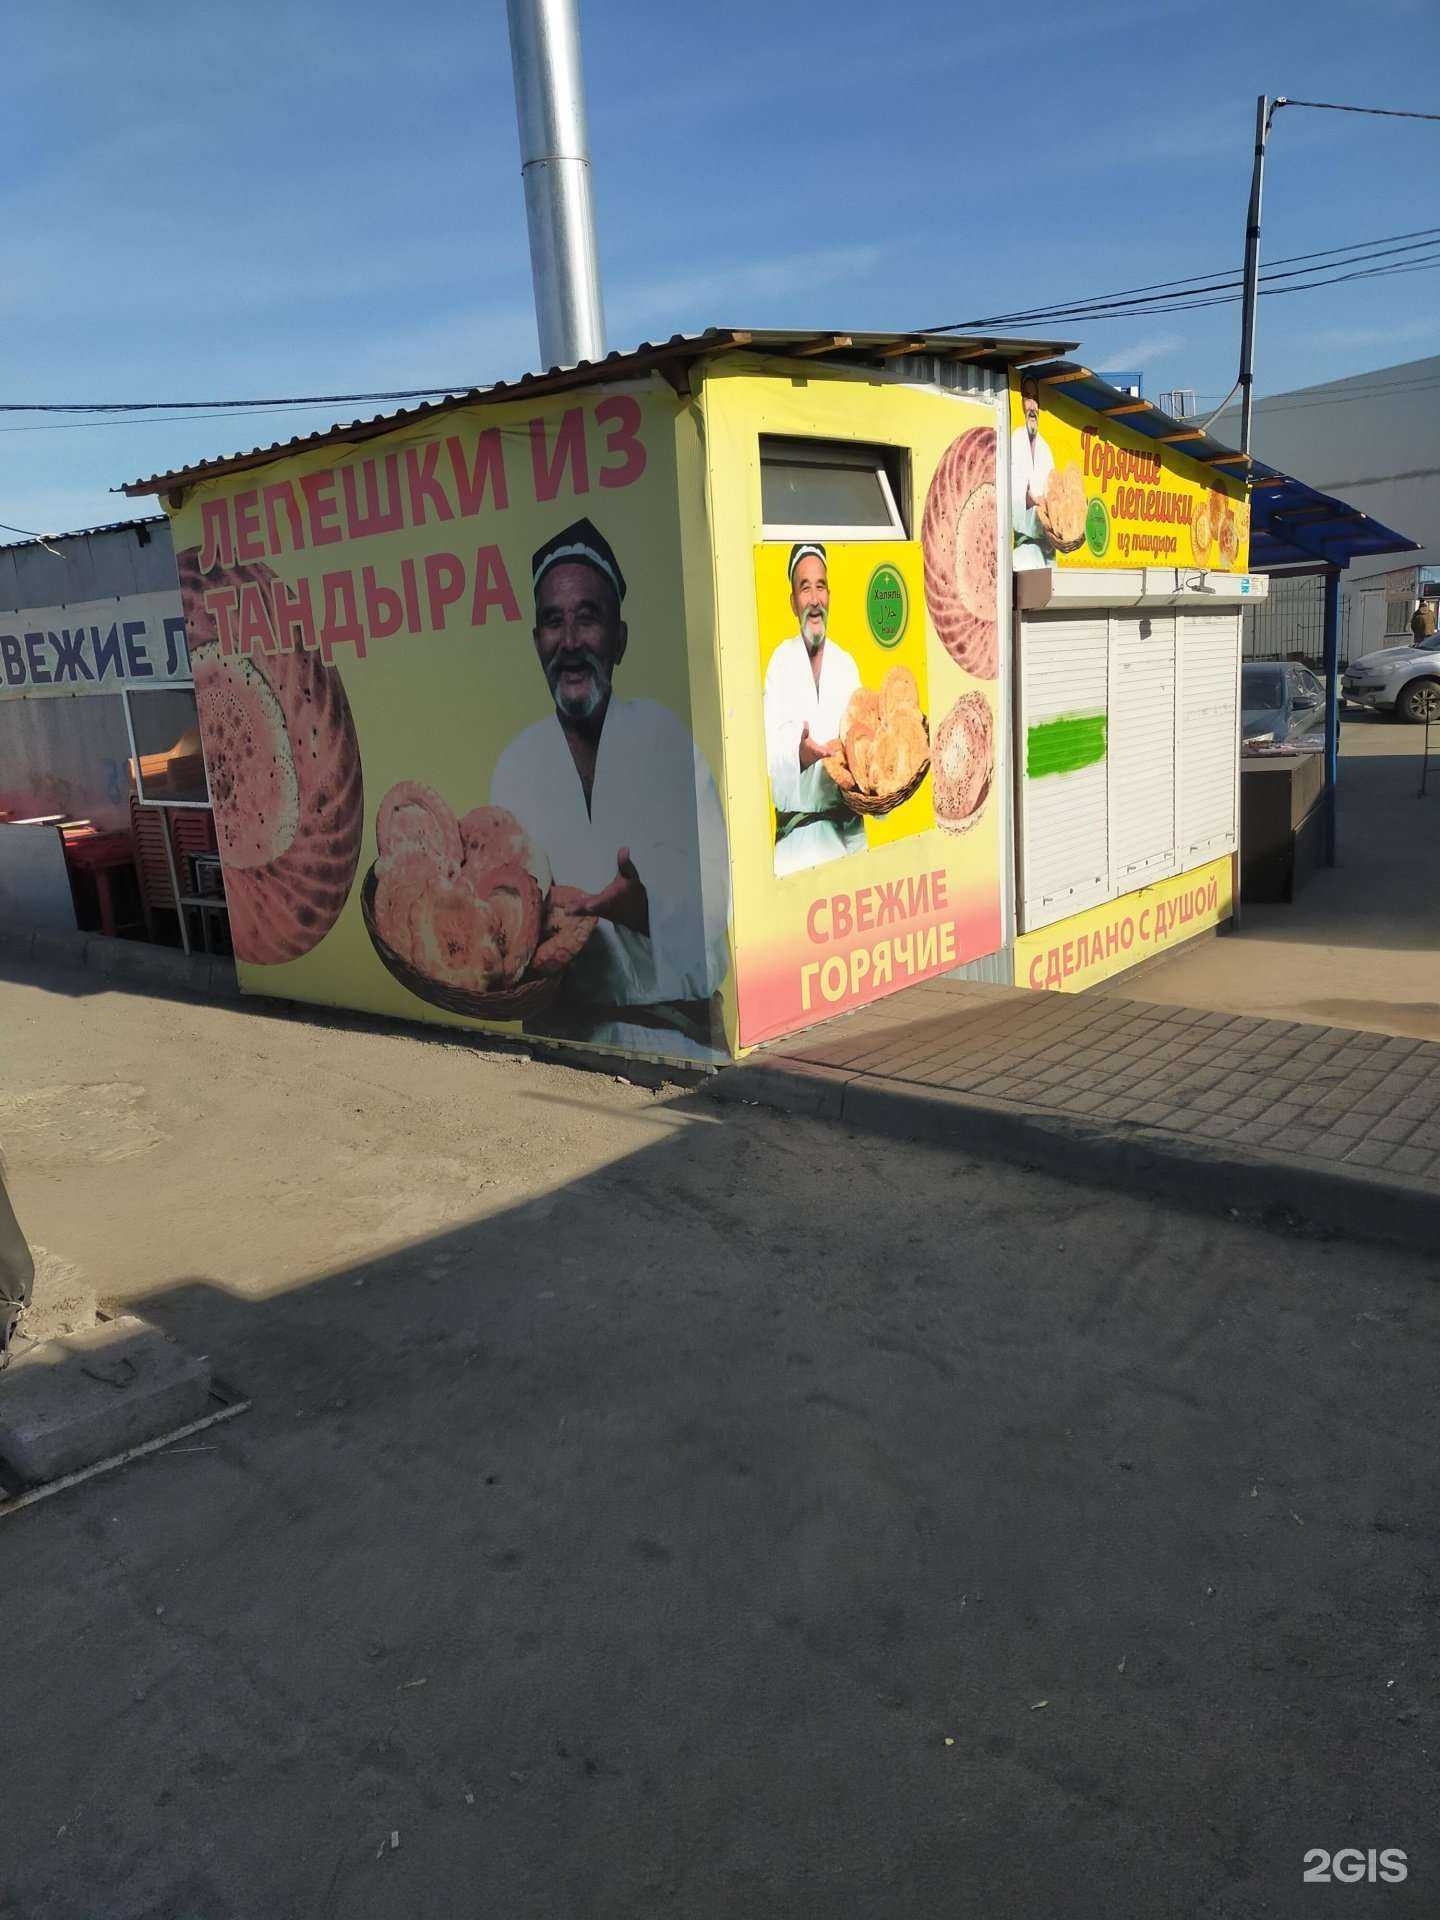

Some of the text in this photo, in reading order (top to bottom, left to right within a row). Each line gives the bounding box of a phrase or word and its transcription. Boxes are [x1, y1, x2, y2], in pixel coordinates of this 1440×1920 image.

[200, 395, 647, 570] ЛЕПЕШКИ ИЗ
[1081, 425, 1162, 493] Горячие
[1117, 532, 1131, 557] из
[1131, 533, 1177, 559] тандыра
[205, 543, 523, 663] ТАНДЫРА
[0, 621, 153, 686] ВЕЖИЕ
[807, 869, 949, 944] СВЕЖИЕ
[1029, 875, 1218, 991] СДЕЛАНО С ДУШОЙ
[801, 921, 956, 1011] ГОРЯЧИЕ
